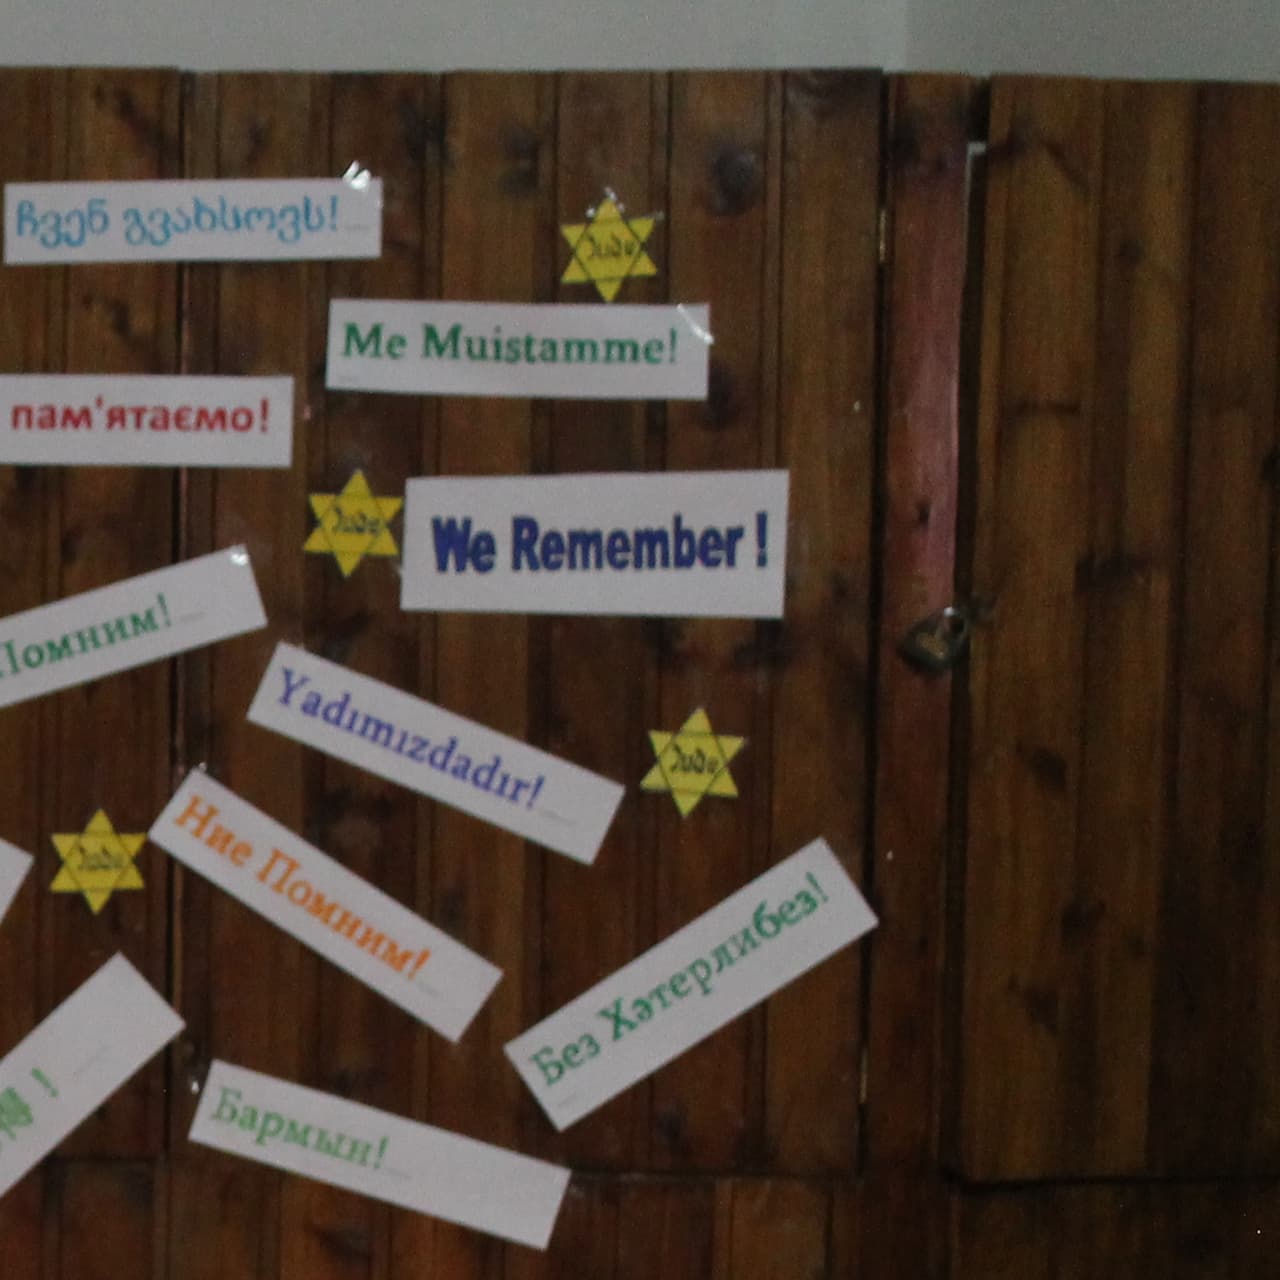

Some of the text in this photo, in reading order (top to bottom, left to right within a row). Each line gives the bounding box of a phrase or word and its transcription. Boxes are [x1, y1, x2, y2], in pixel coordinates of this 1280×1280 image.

[17, 199, 109, 247] ჩვენ
[343, 321, 679, 364] Me Muistamme!
[434, 519, 495, 573] We
[513, 517, 744, 571] Remember
[172, 794, 431, 977] Ние Помним!
[532, 1036, 601, 1085] Без
